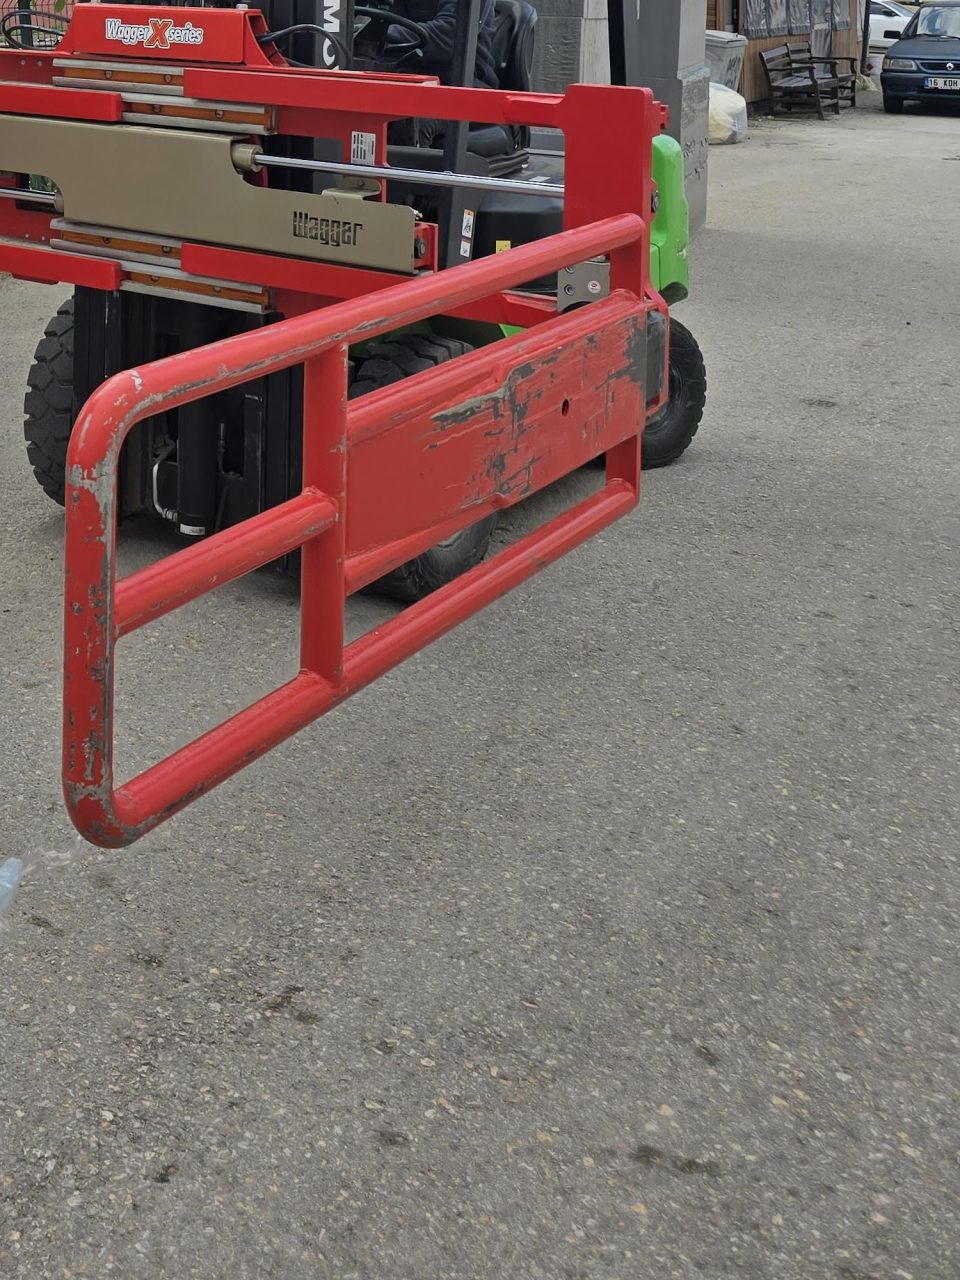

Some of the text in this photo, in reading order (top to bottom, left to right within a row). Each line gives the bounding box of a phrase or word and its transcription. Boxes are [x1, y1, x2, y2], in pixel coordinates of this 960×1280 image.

[106, 19, 149, 45] Wagger
[168, 22, 203, 44] series
[293, 211, 363, 247] Wagger
